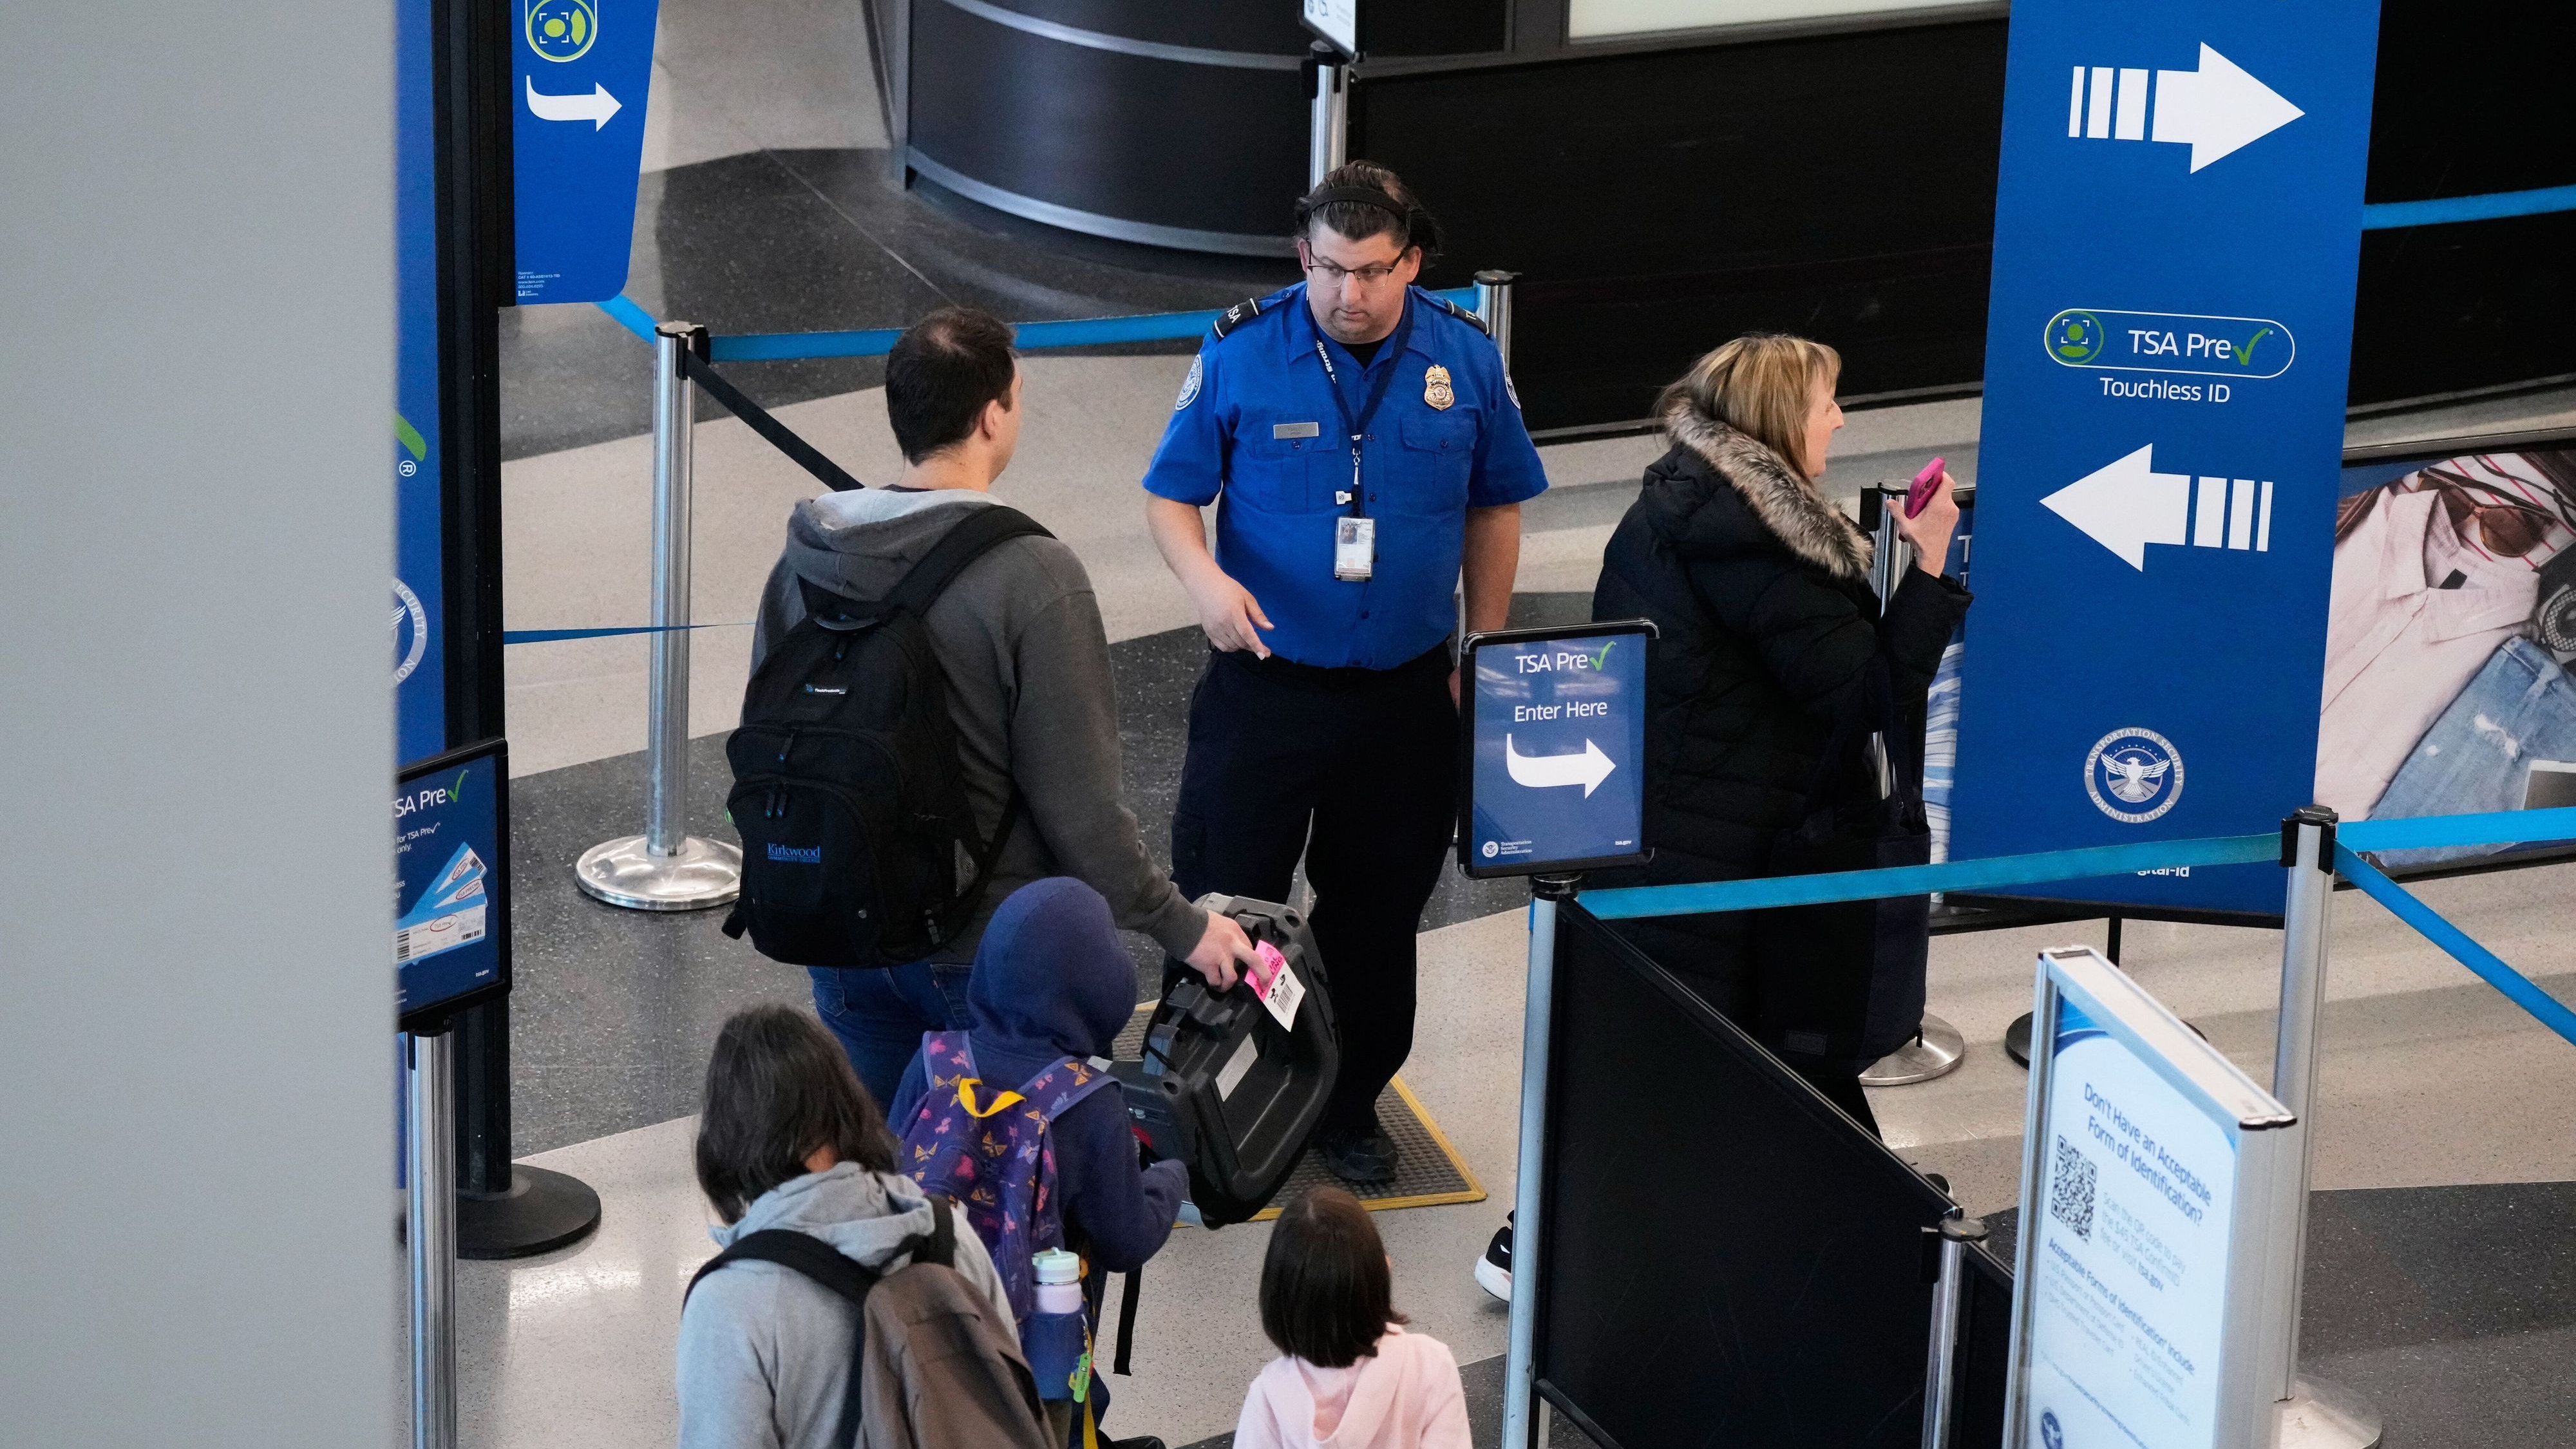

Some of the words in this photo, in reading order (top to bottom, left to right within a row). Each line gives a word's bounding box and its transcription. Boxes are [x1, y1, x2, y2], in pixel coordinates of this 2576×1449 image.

[2128, 330, 2179, 356] TSA
[2187, 333, 2231, 359] Pre
[2099, 377, 2201, 401] Touchless
[2208, 383, 2231, 402] ID
[1515, 652, 1552, 674] TSA
[1556, 652, 1589, 671] Pre
[1514, 705, 1561, 723] Enter
[1566, 700, 1608, 718] Here
[2085, 728, 2159, 777] TRANSPORTATION
[2161, 739, 2183, 786] SECURITY
[392, 795, 417, 818] SA
[419, 788, 446, 810] Pre
[2089, 790, 2174, 823] ADMINISTRATION
[397, 843, 412, 853] only.
[407, 830, 420, 840] TSA
[767, 842, 820, 858] Kirkwood
[2084, 1082, 2112, 1120] Don't
[2113, 1106, 2141, 1144] Have
[2142, 1134, 2156, 1157] an
[2157, 1145, 2211, 1207] Acceptable
[2088, 1115, 2116, 1152] Form
[2117, 1142, 2129, 1162] of
[2130, 1150, 2203, 1227] Identification?
[2049, 1237, 2086, 1278] Acceptable
[2087, 1271, 2108, 1298] Forms
[2109, 1293, 2117, 1305] of
